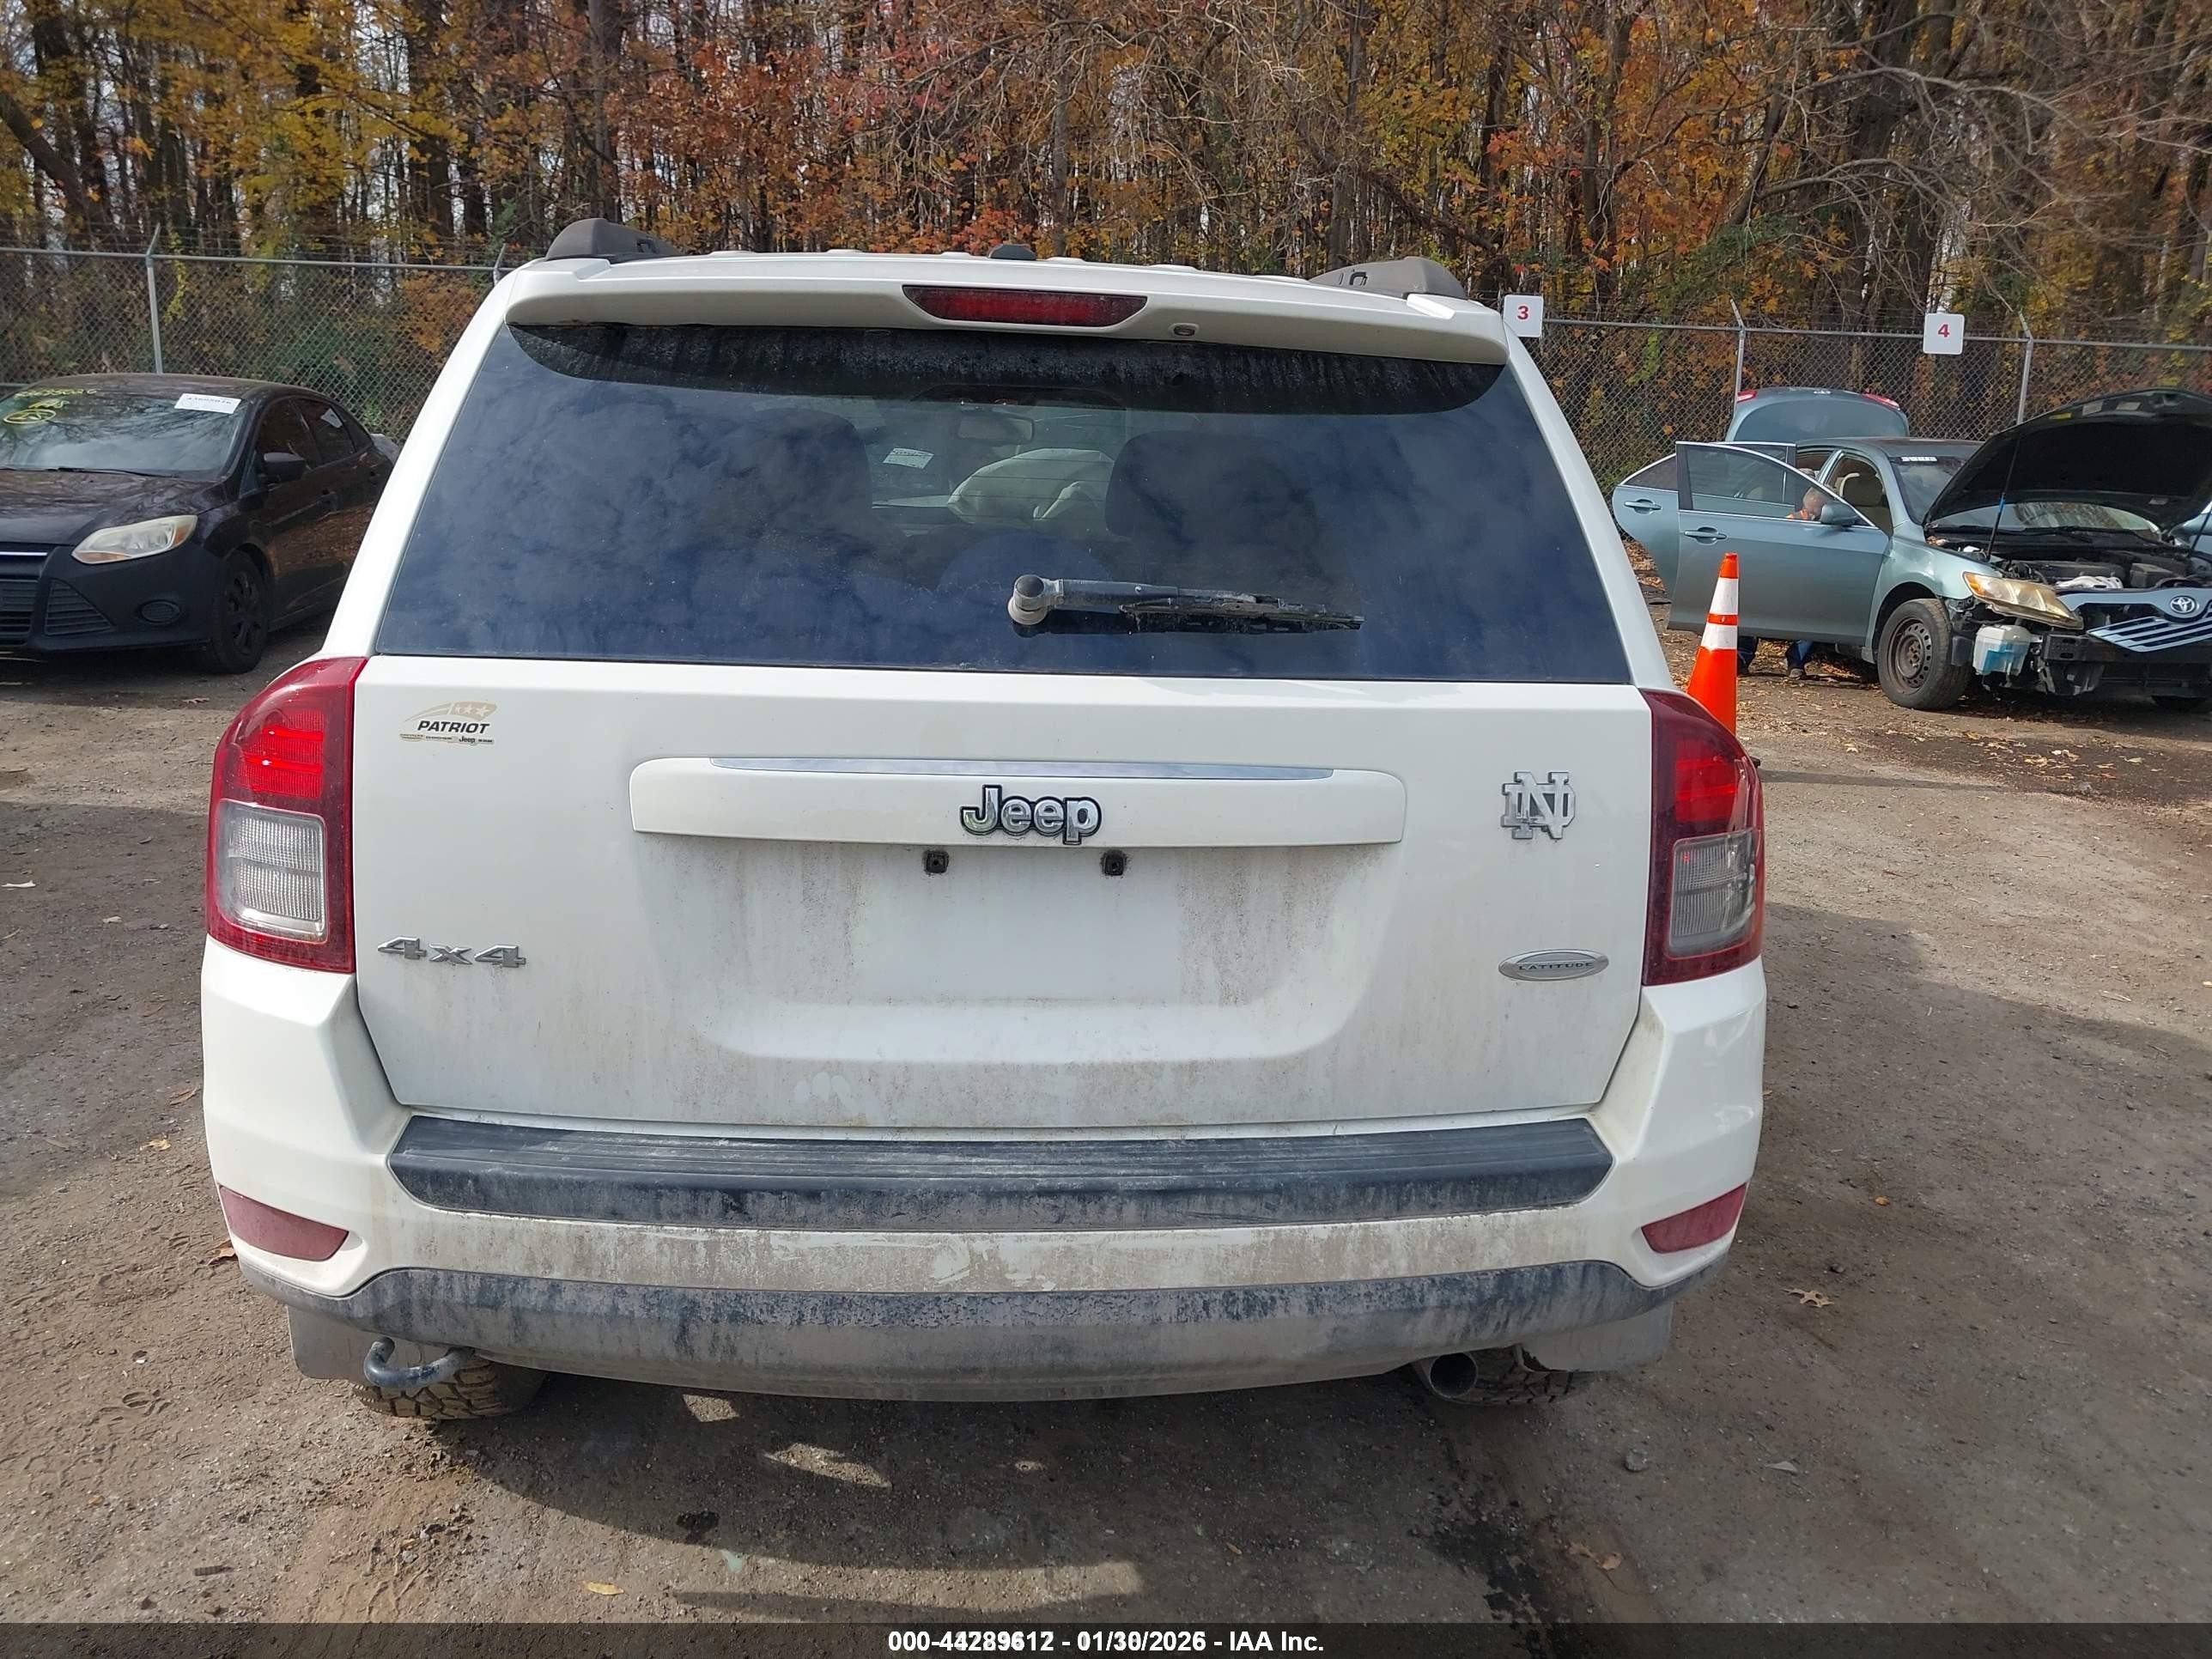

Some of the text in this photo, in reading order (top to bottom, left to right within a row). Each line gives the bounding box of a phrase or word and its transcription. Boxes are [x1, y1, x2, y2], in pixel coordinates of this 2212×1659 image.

[1516, 305, 1529, 320] 3
[1937, 324, 1950, 338] 4
[417, 720, 490, 734] PATRIOT
[459, 735, 476, 744] Jeep
[960, 784, 1102, 846] Jeep
[377, 936, 526, 969] 4x4
[1518, 962, 1595, 971] LATITUDE
